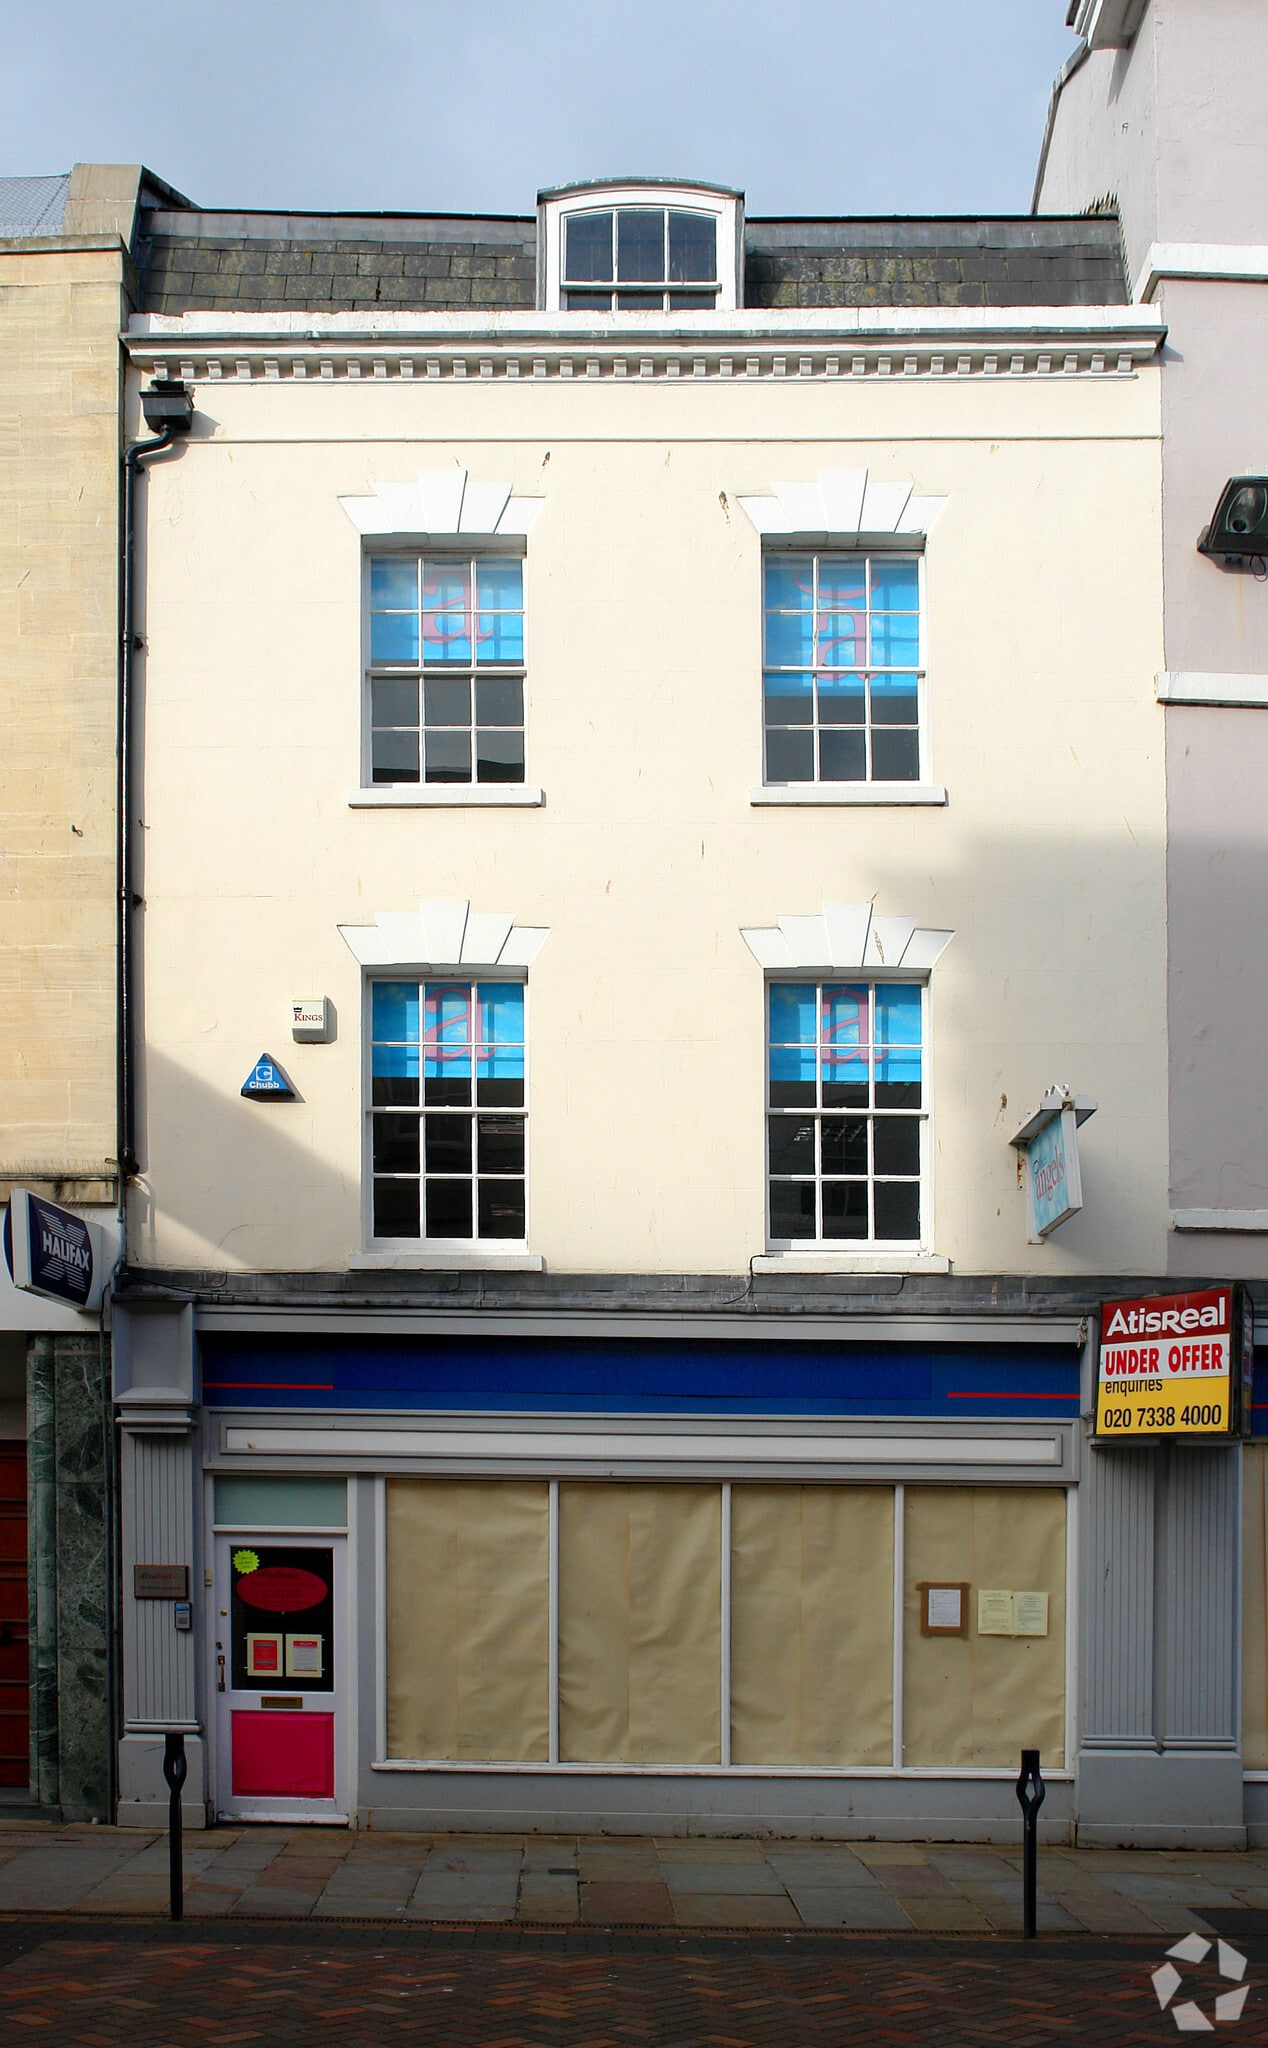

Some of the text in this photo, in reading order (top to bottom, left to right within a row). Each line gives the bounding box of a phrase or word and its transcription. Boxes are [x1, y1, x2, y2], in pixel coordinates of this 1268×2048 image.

[421, 570, 494, 645] a
[423, 986, 497, 1063] a
[813, 989, 889, 1066] a
[249, 1081, 280, 1089] Chubb
[42, 1230, 90, 1272] HALIFAX
[1106, 1296, 1226, 1337] AtisReal
[1105, 1348, 1160, 1376] UNDER
[1168, 1343, 1223, 1373] OFFER
[1105, 1379, 1163, 1397] enquiries
[1104, 1405, 1221, 1428] 020 7338 4000
